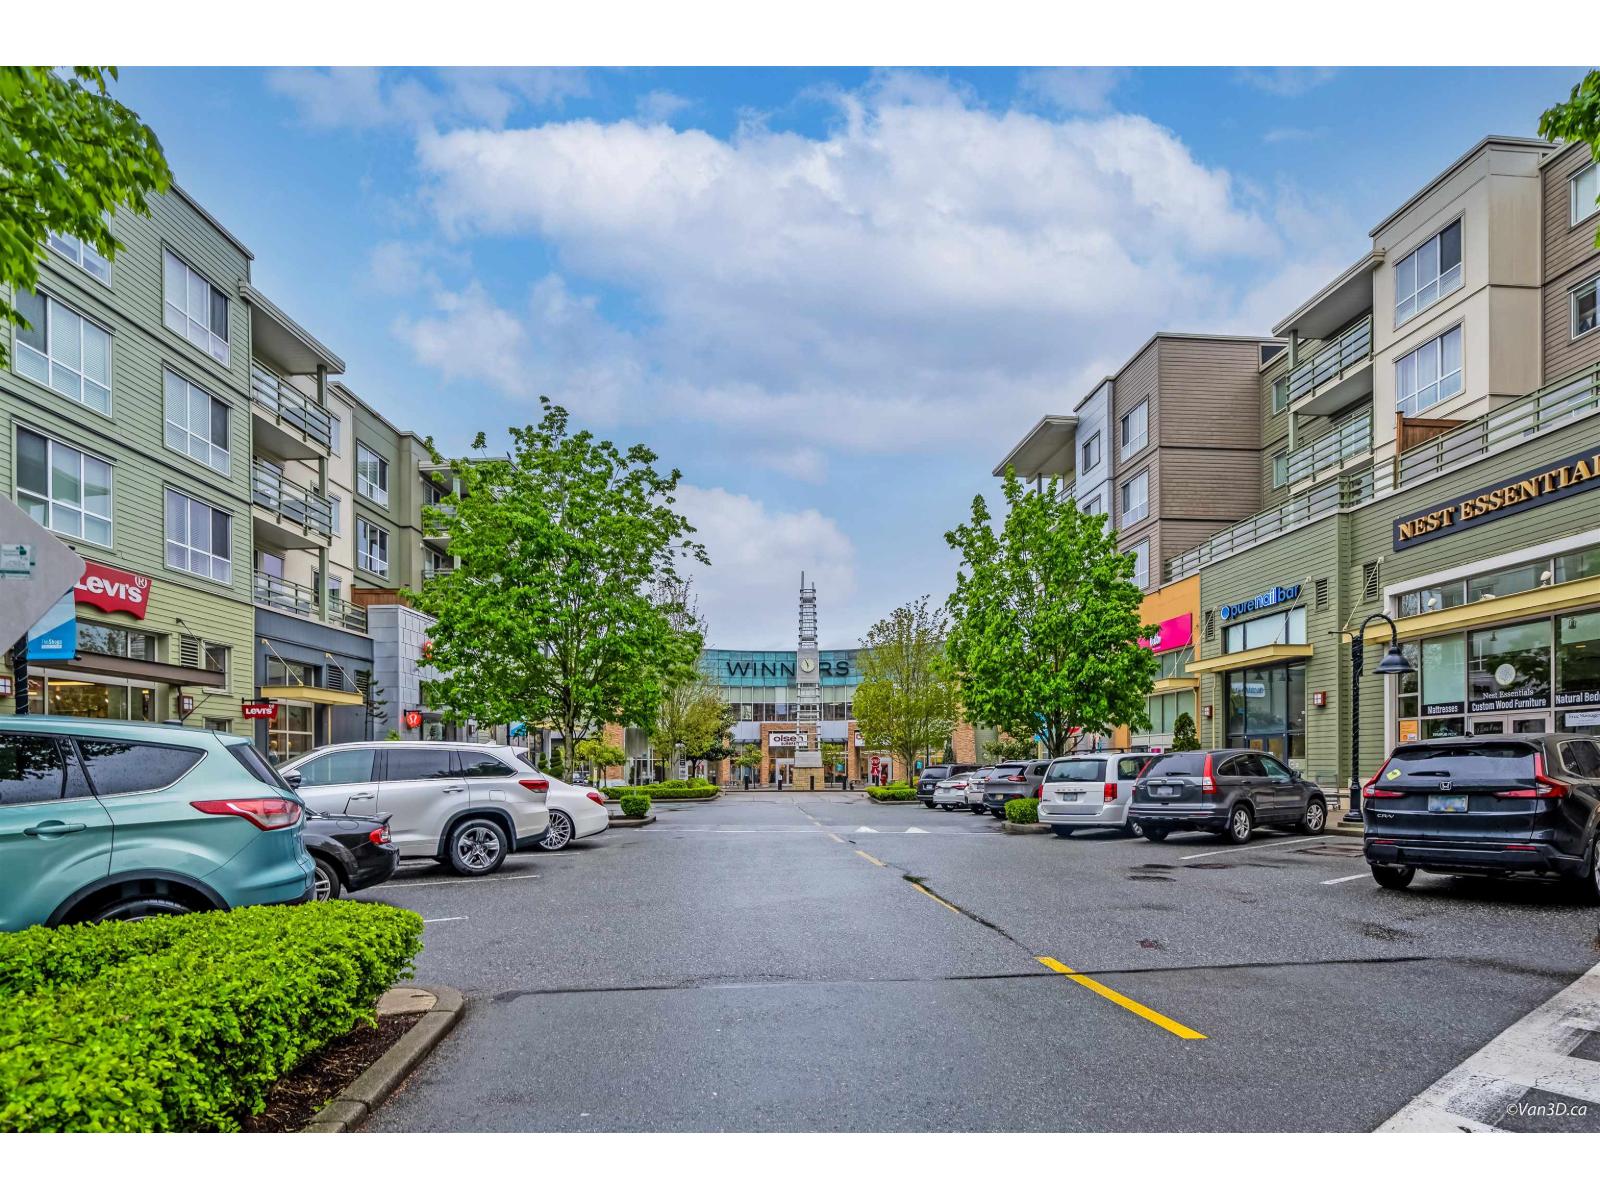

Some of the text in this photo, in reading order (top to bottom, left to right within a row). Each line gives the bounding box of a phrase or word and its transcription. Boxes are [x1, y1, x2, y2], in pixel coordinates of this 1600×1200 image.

[1398, 506, 1456, 542] NEST
[726, 660, 850, 677] WINNRS
[1482, 688, 1534, 700] Nest Essentials
[1555, 690, 1600, 705] Natural Bed
[1471, 697, 1547, 712] Custom Wood Furniture
